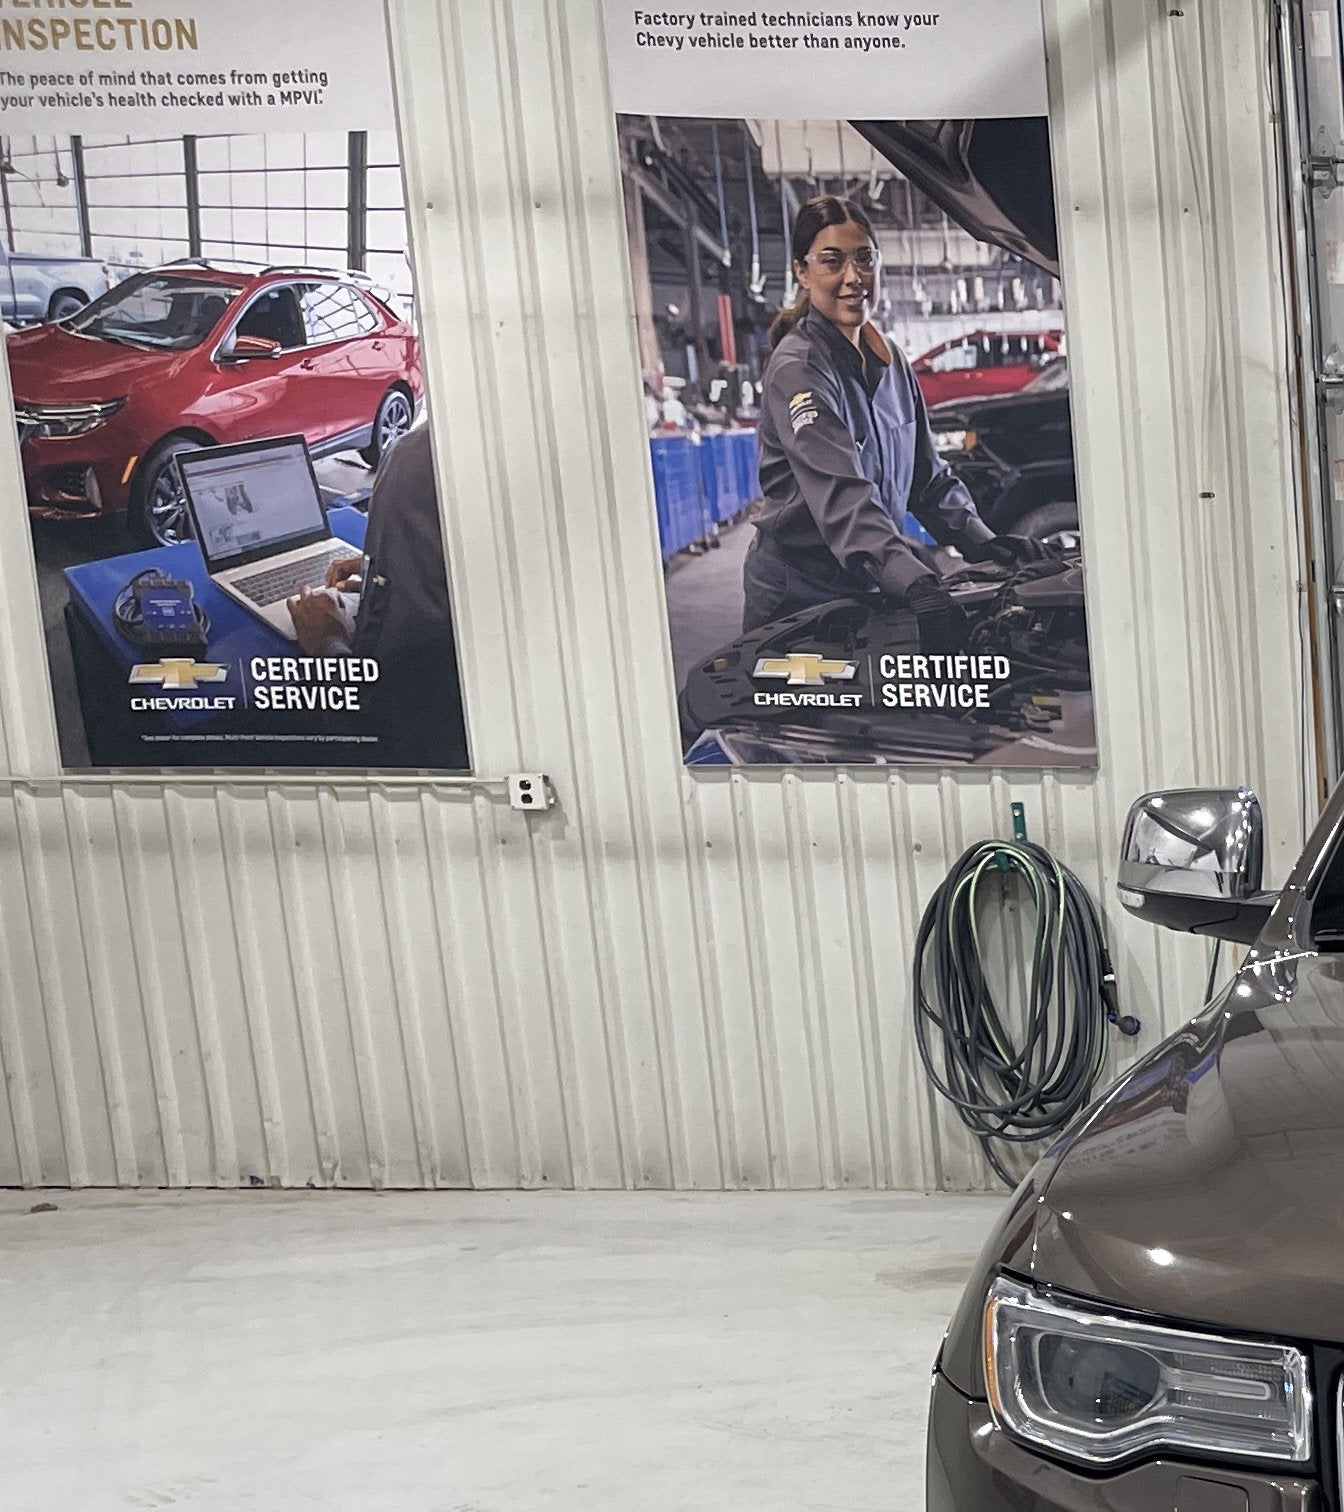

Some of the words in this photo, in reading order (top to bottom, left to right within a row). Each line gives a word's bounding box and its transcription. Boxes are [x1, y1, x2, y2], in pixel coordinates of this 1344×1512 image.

[634, 10, 695, 29] Factory
[700, 11, 757, 27] trained
[761, 11, 852, 27] technicians
[857, 11, 898, 27] know
[903, 13, 939, 29] your
[0, 18, 198, 50] NSPECTION
[636, 31, 684, 50] Chevy
[689, 32, 744, 49] vehicle
[749, 33, 799, 49] better
[803, 33, 840, 49] than
[844, 35, 906, 52] anyone.
[0, 71, 25, 86] The
[30, 73, 74, 90] peace
[80, 71, 94, 86] of
[99, 71, 136, 86] mind
[141, 71, 173, 86] that
[177, 73, 226, 86] comes
[230, 69, 268, 85] from
[272, 69, 328, 88] getting
[1, 95, 34, 111] your
[39, 91, 104, 107] vehicle's
[108, 91, 157, 107] health
[161, 90, 224, 107] checked
[228, 91, 262, 106] with
[267, 95, 276, 106] a
[250, 656, 380, 683] CERTIFIED
[879, 654, 1011, 680] CERTIFIED
[130, 696, 236, 711] CHEVROLET
[254, 685, 361, 711] SERVICE
[753, 692, 863, 707] CHEVROLET
[881, 683, 991, 708] SERVICE
